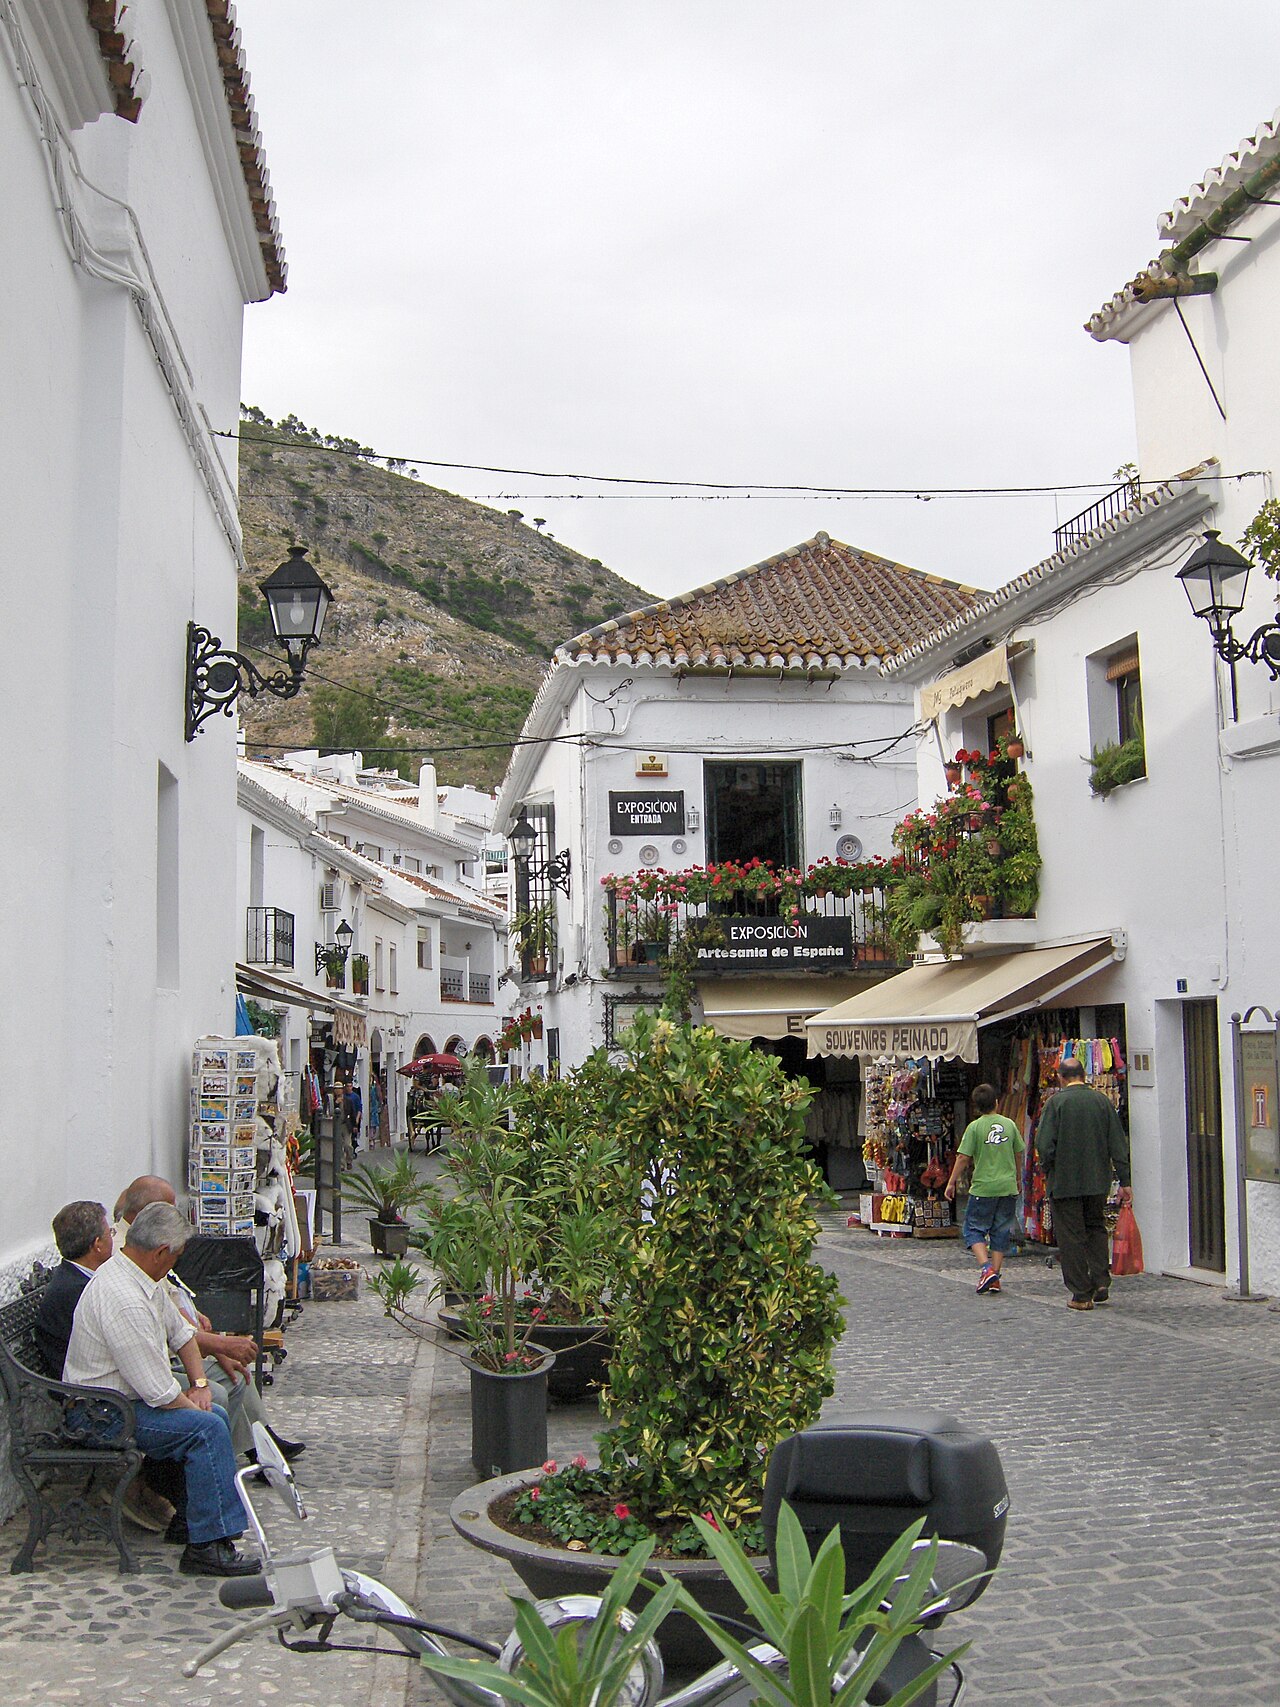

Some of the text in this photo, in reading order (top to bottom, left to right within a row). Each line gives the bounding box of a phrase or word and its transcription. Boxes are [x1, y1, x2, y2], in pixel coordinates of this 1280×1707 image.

[630, 814, 662, 824] ENTRADA
[730, 925, 808, 940] EXPOSICION
[771, 946, 789, 957] de
[793, 945, 844, 958] España
[826, 1027, 949, 1051] SOUVENIRS PEINADO
